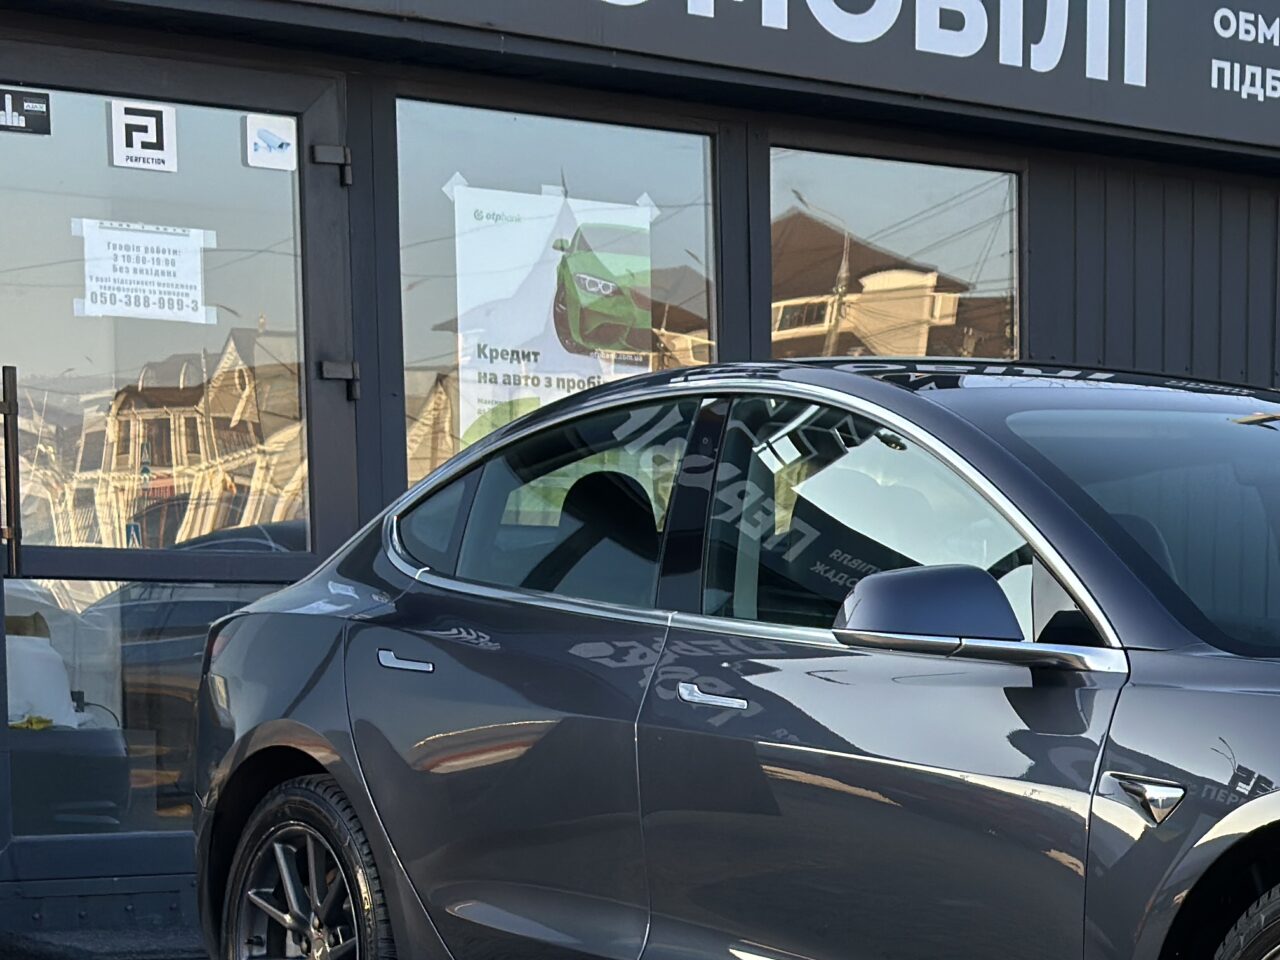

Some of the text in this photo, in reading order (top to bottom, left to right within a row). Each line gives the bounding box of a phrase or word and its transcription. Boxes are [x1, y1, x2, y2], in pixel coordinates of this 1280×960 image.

[125, 154, 166, 167] PERFECTION
[477, 343, 541, 363] Кредит
[477, 371, 609, 393] на авто з пробі
